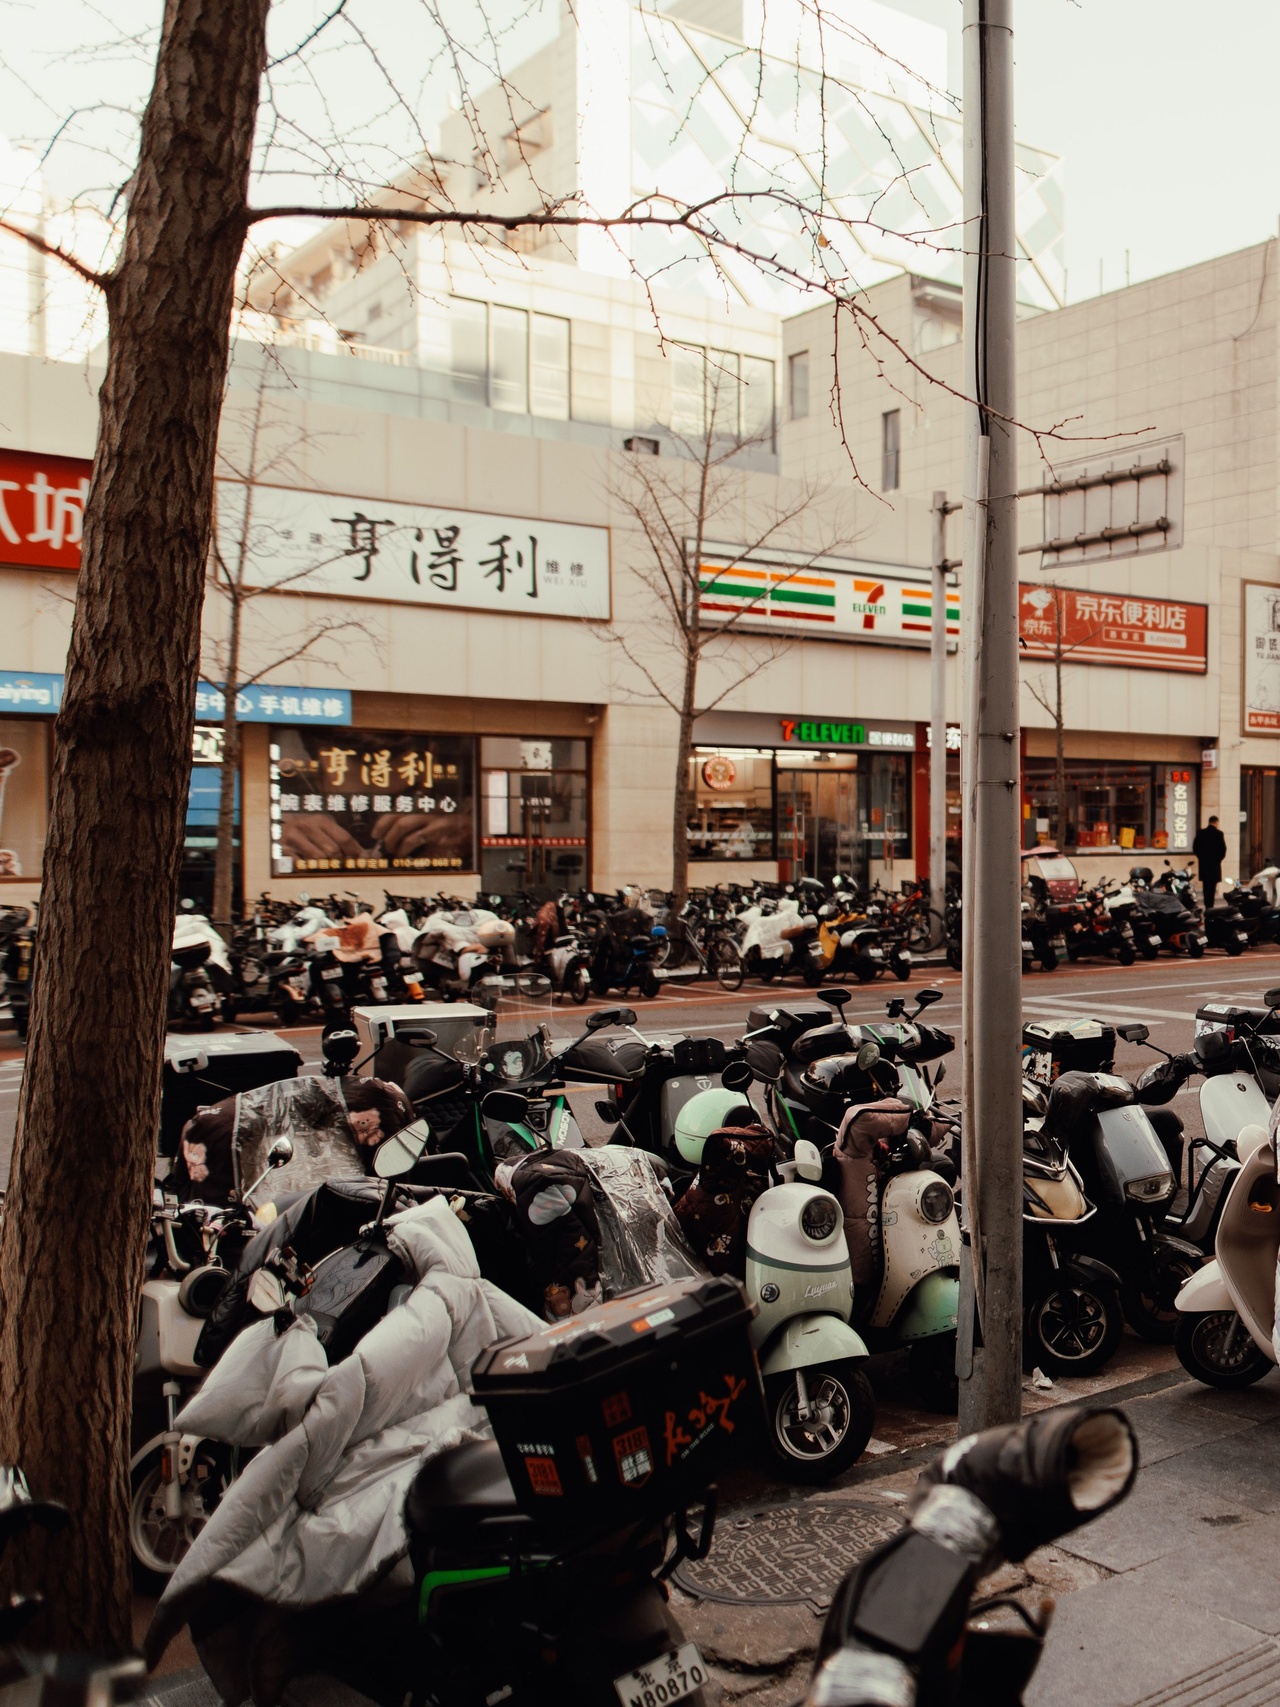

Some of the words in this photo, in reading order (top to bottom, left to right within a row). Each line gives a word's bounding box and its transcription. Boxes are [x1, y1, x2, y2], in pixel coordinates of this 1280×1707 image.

[330, 512, 538, 599] 亨得利
[543, 575, 563, 586] WEI
[569, 579, 587, 588] XIU
[1075, 596, 1187, 630] 京东便利店
[1024, 619, 1053, 635] 京东
[259, 695, 344, 717] 手机维修
[319, 746, 433, 789] 亨得利
[280, 793, 457, 814] 腕表维修服务中心
[1173, 784, 1188, 848] 名烟名酒
[804, 1280, 838, 1298] Luyuan
[639, 1660, 682, 1688] 北京
